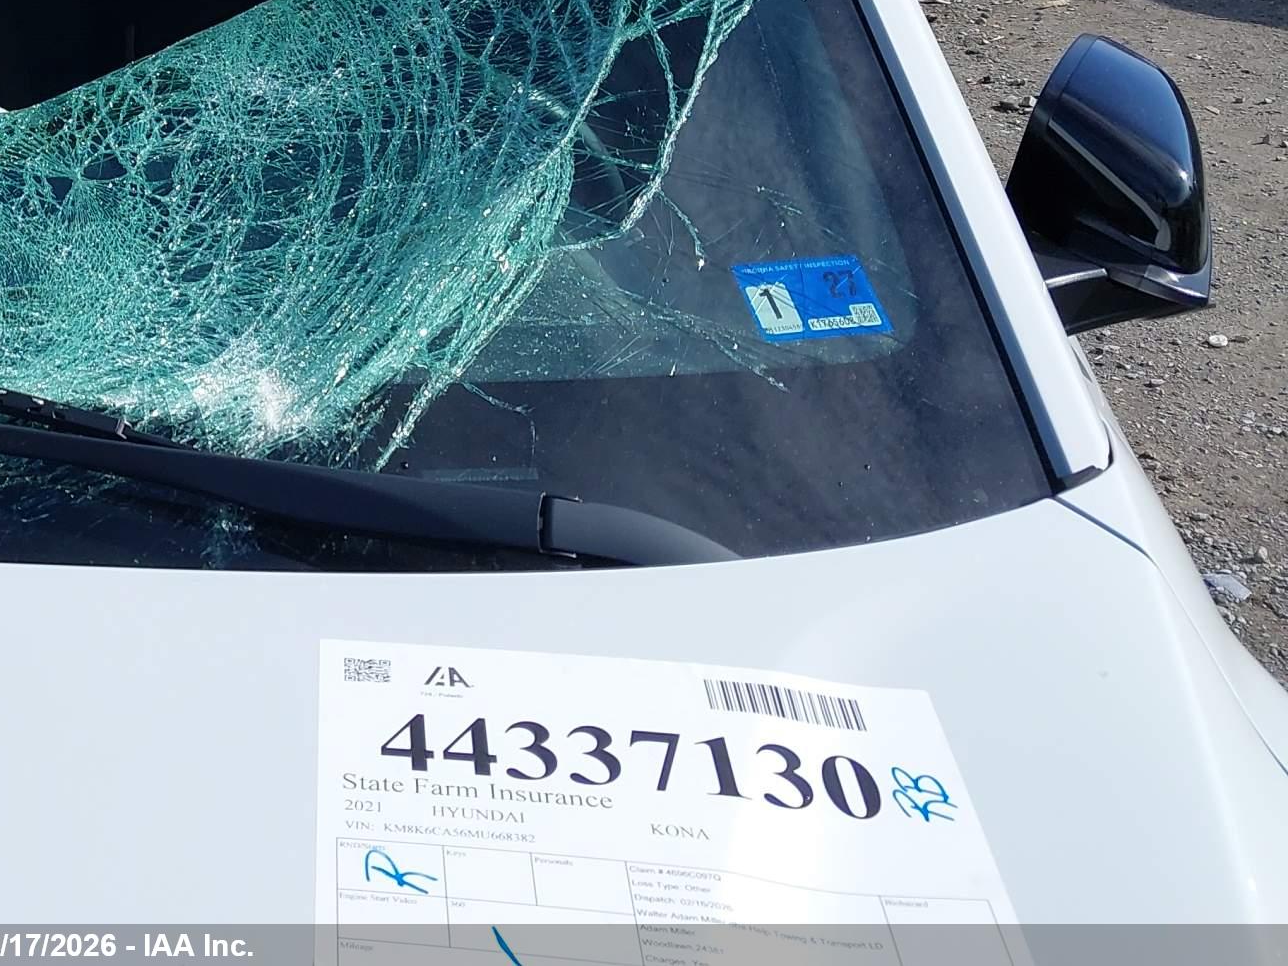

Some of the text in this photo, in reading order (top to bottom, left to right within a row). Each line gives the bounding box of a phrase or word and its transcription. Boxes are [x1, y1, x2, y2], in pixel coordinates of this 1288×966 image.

[804, 260, 850, 269] INSPECTION
[822, 270, 857, 298] 27
[759, 288, 783, 320] 1
[380, 713, 881, 820] 44337130
[342, 773, 614, 809] State Farm Insurance
[344, 799, 710, 841] 2021 HYUNDAI KONA
[345, 820, 374, 831] VIN:
[446, 849, 467, 858] Keys
[629, 865, 656, 875] Claim
[632, 879, 653, 888] Loss
[684, 885, 711, 893] Other
[637, 909, 667, 918] Walter
[671, 912, 698, 922] Adam
[773, 929, 807, 944] Towing
[819, 937, 866, 950] Transport
[640, 924, 696, 935] Adam Miller
[340, 941, 373, 953] Mileage
